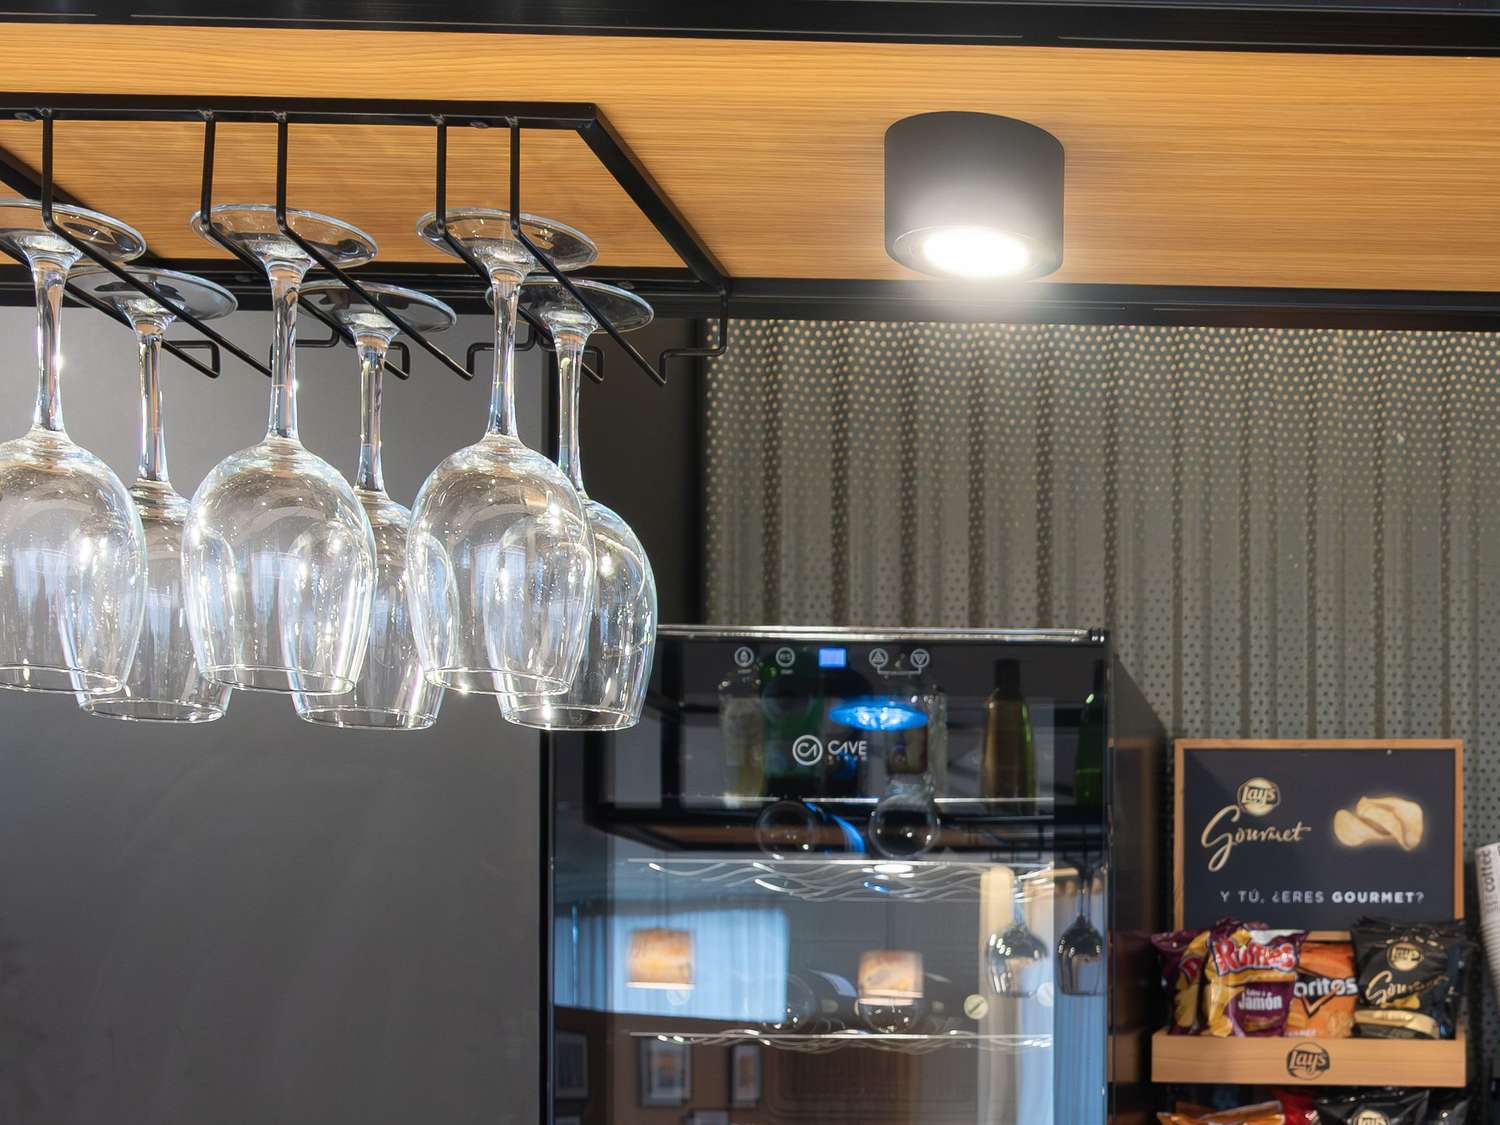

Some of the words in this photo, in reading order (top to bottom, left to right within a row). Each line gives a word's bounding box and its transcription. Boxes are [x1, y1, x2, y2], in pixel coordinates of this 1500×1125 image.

[828, 740, 868, 756] CAVE
[1201, 805, 1312, 873] Gourmet
[1220, 890, 1230, 903] Y
[1272, 890, 1325, 904] ¿ERES
[1332, 890, 1424, 904] GOURMET?
[1293, 976, 1359, 997] oritos
[1238, 991, 1283, 1011] Jamón
